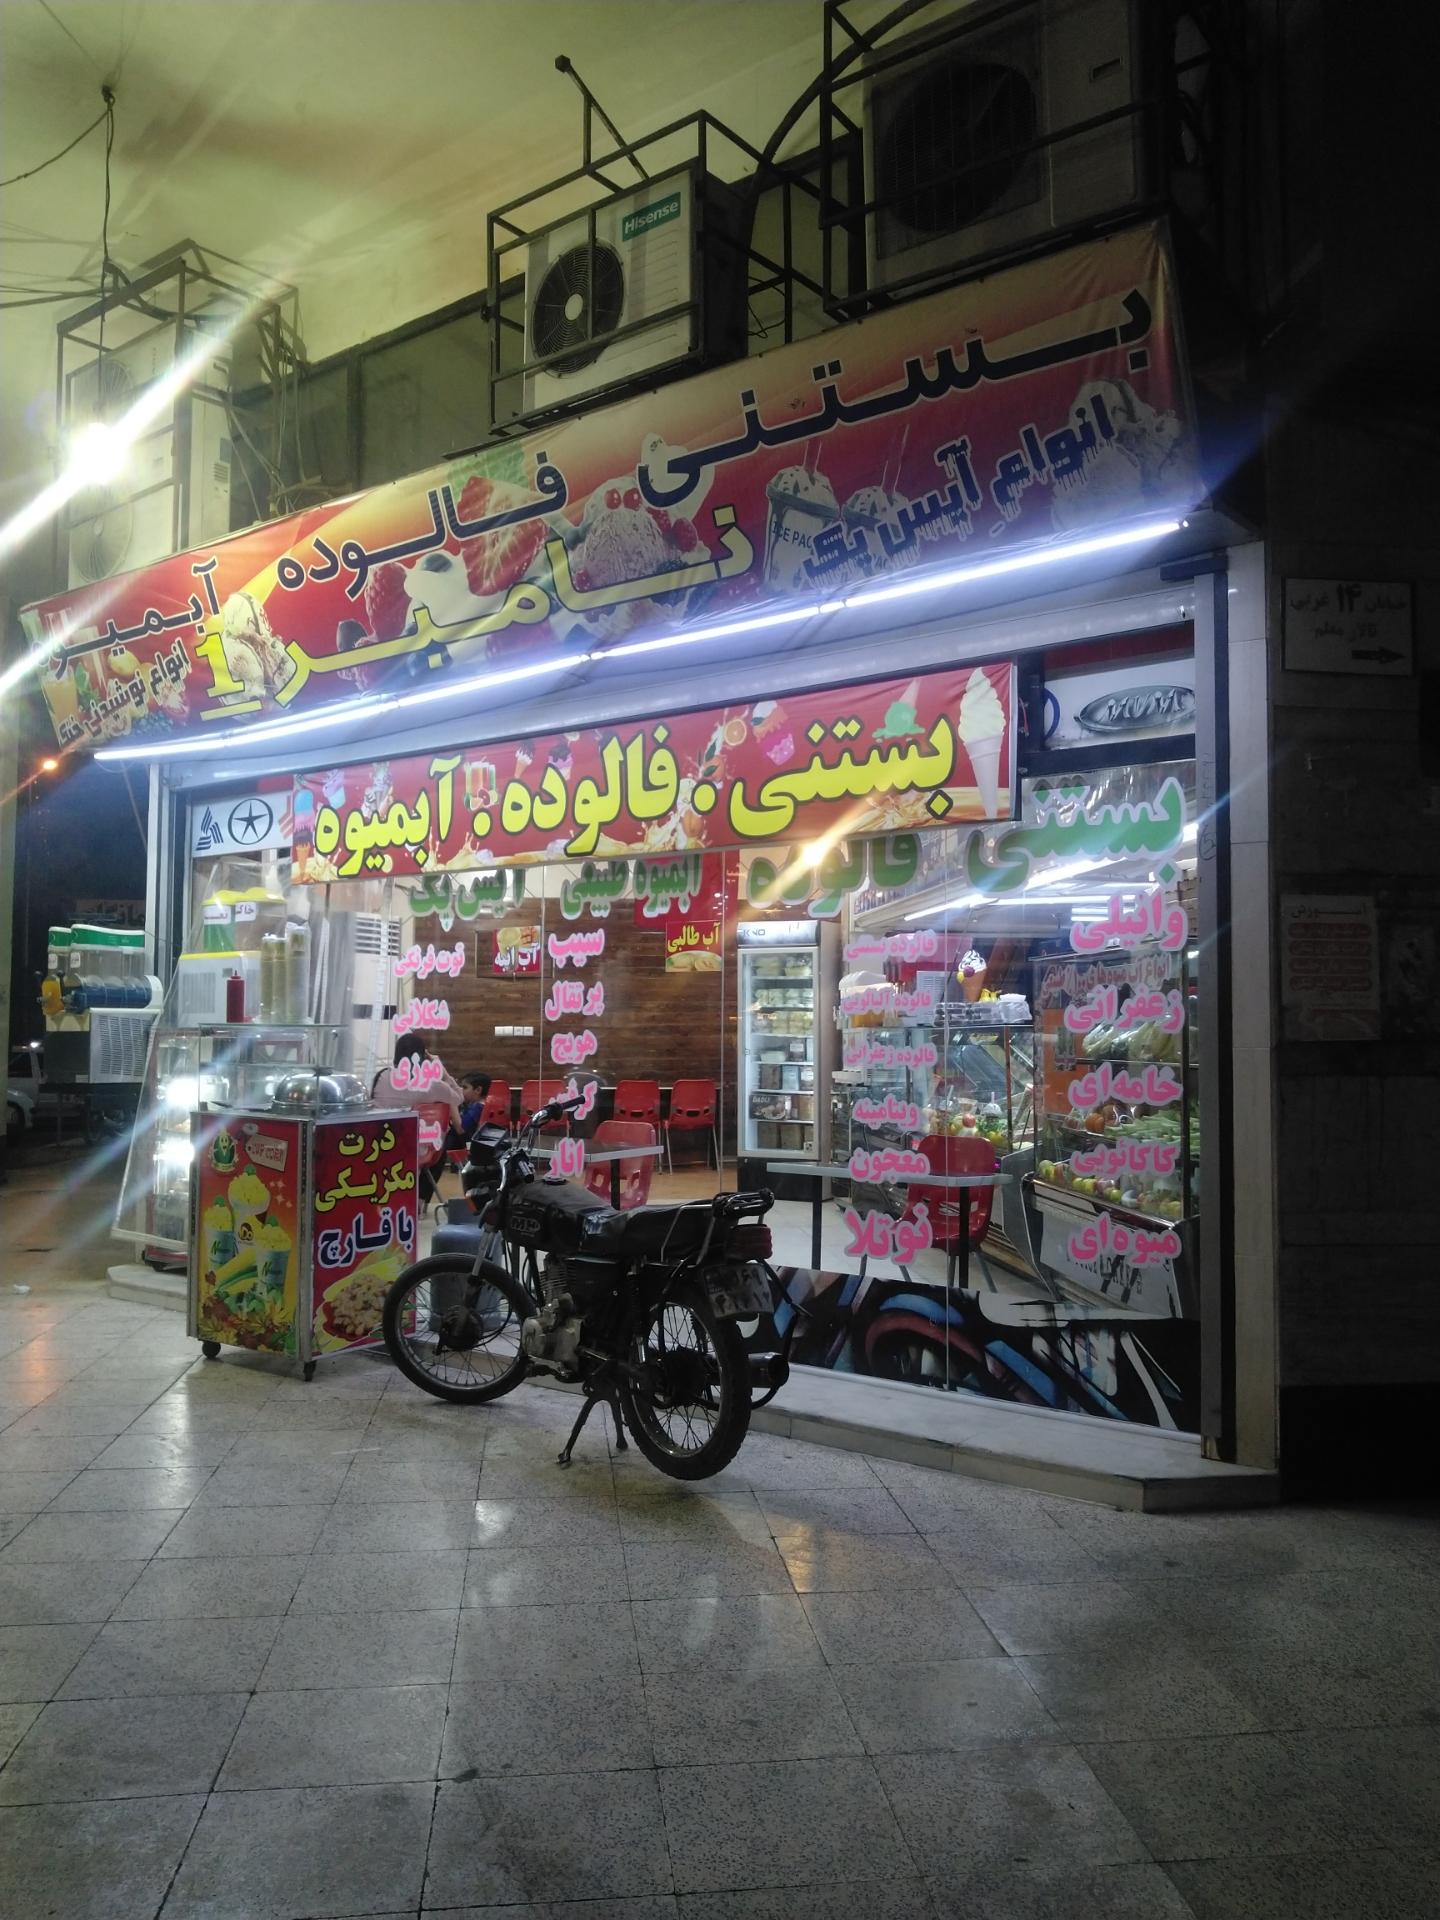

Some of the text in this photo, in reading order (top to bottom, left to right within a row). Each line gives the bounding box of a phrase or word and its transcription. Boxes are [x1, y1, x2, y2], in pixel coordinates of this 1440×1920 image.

[624, 200, 679, 235] Hisense
[638, 289, 1152, 507] بستنی
[277, 451, 569, 601] فالوده
[313, 713, 955, 878] بستنی فالوده آبمیوه
[965, 775, 1187, 894] بستنی
[560, 859, 630, 920] طبیعی
[667, 921, 721, 953] آب طالبی
[1070, 888, 1189, 952] وانیلی
[517, 942, 541, 971] آب
[547, 927, 605, 969] سیب
[887, 929, 938, 963] فالوده
[1064, 982, 1186, 1034] زعفرانی
[550, 1029, 598, 1064] هویج
[895, 1043, 938, 1071] فالوده
[390, 1052, 443, 1092] موزی
[851, 1093, 920, 1131] ویتامینه
[337, 1122, 396, 1163] ذرت
[314, 1160, 416, 1213] مکزیکی
[849, 1146, 931, 1185] معجون
[318, 1206, 415, 1268] با قارچ
[843, 1202, 933, 1266] نوتلا
